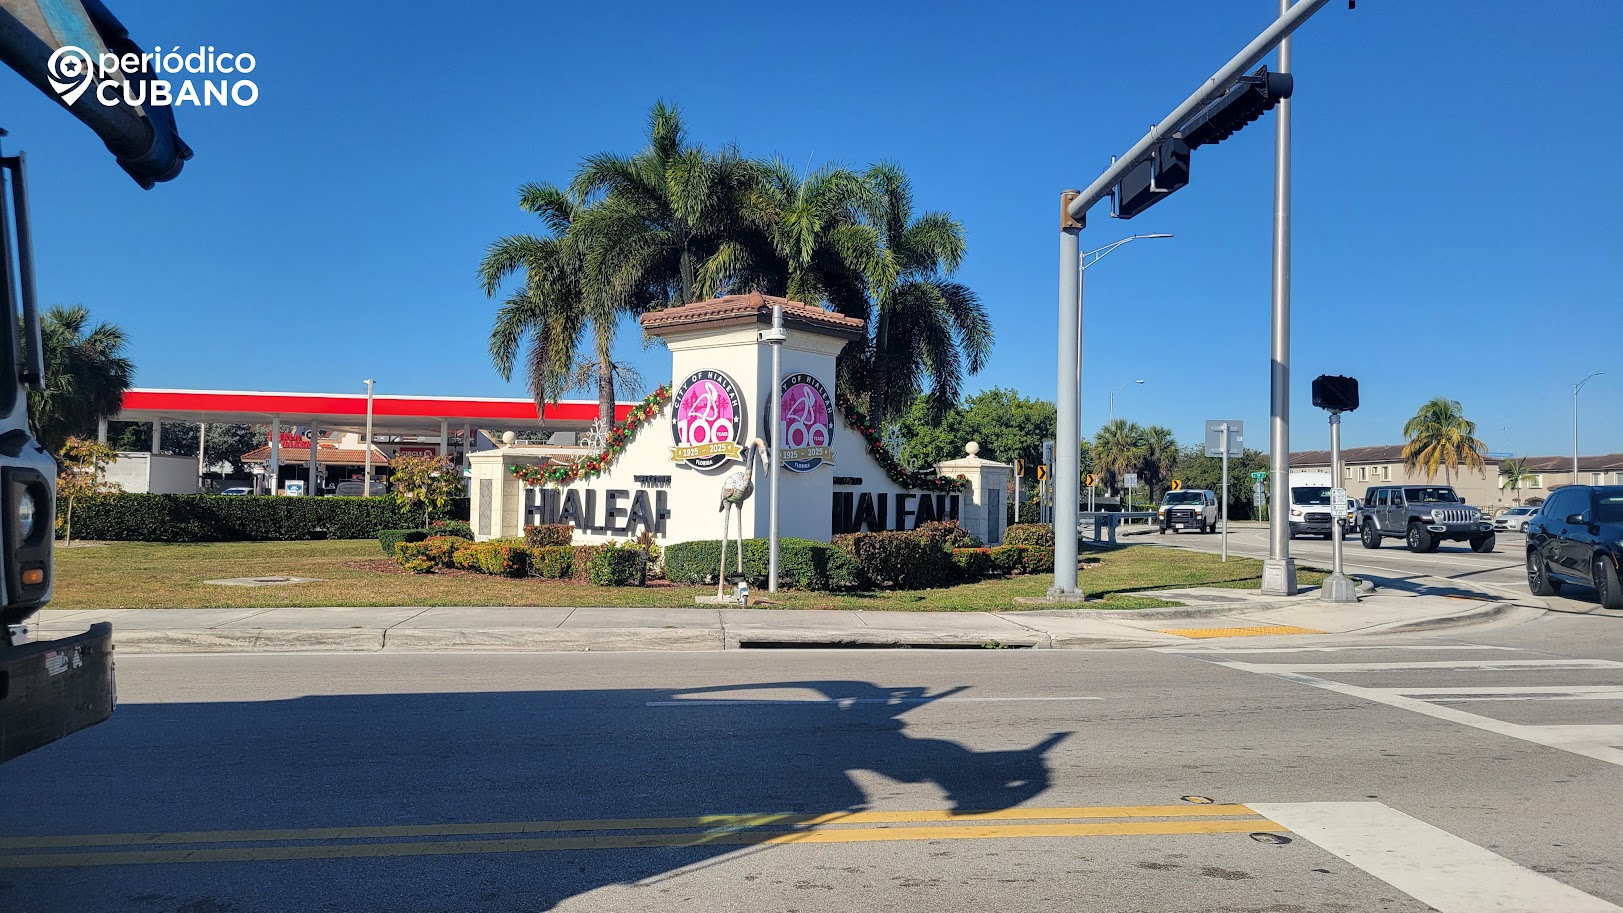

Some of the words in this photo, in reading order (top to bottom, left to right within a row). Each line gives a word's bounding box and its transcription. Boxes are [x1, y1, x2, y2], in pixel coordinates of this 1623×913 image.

[674, 383, 688, 408] CITY
[692, 372, 703, 382] OF
[708, 371, 738, 407] HIALEAH
[792, 375, 801, 383] OF
[806, 376, 832, 413] HIALEAH
[678, 418, 734, 447] 100
[683, 448, 699, 457] 1925
[709, 444, 727, 453] 2025
[783, 451, 798, 459] 1925
[808, 447, 823, 456] 2025
